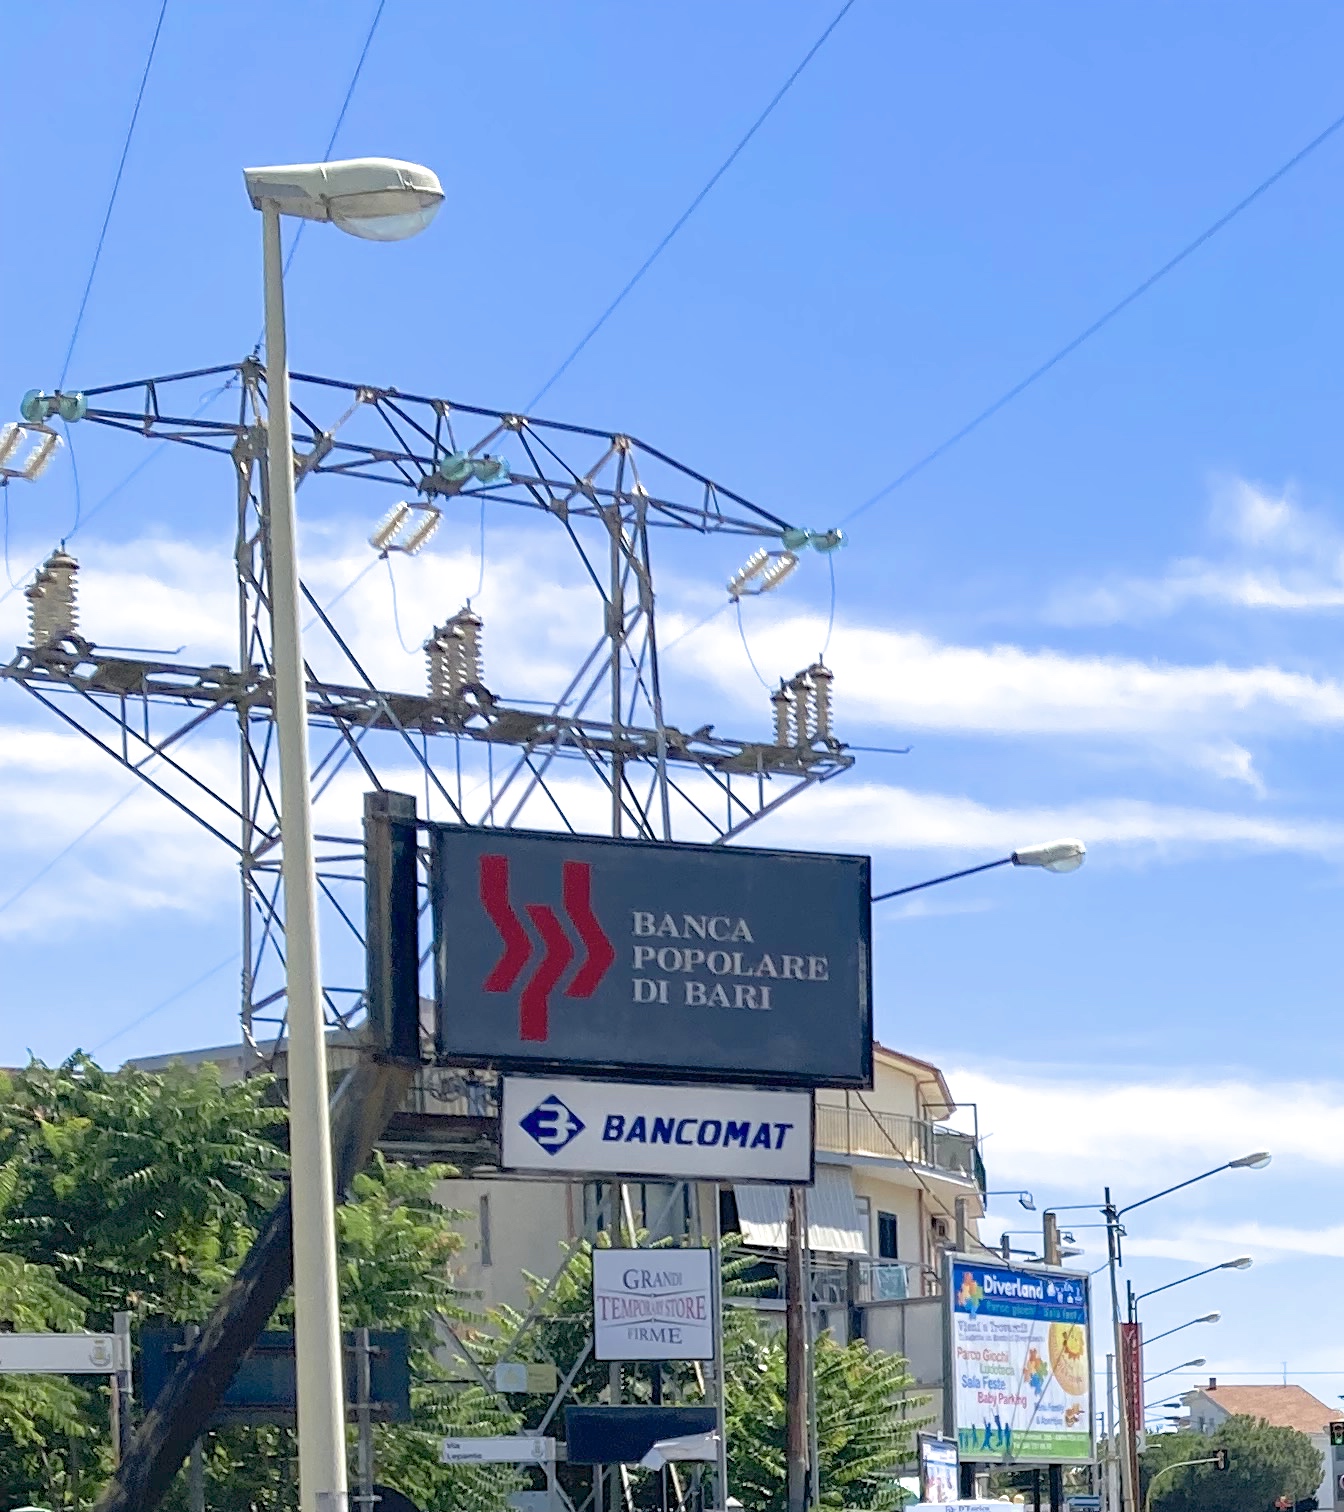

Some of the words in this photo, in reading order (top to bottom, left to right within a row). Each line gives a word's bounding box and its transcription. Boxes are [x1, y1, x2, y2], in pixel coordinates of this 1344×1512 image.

[631, 910, 755, 944] BANCA
[631, 944, 830, 982] POPOLARE
[631, 977, 670, 1005] DI
[684, 980, 773, 1011] BARI
[602, 1114, 795, 1150] BANCOMAT
[622, 1268, 683, 1290] GRANDI
[983, 1273, 1044, 1300] Diverland
[627, 1327, 683, 1345] FIRME
[957, 1346, 980, 1360] Parco
[961, 1374, 980, 1389] Sala
[982, 1376, 1006, 1390] Feste
[977, 1391, 997, 1408] Baby
[998, 1392, 1027, 1410] Parking
